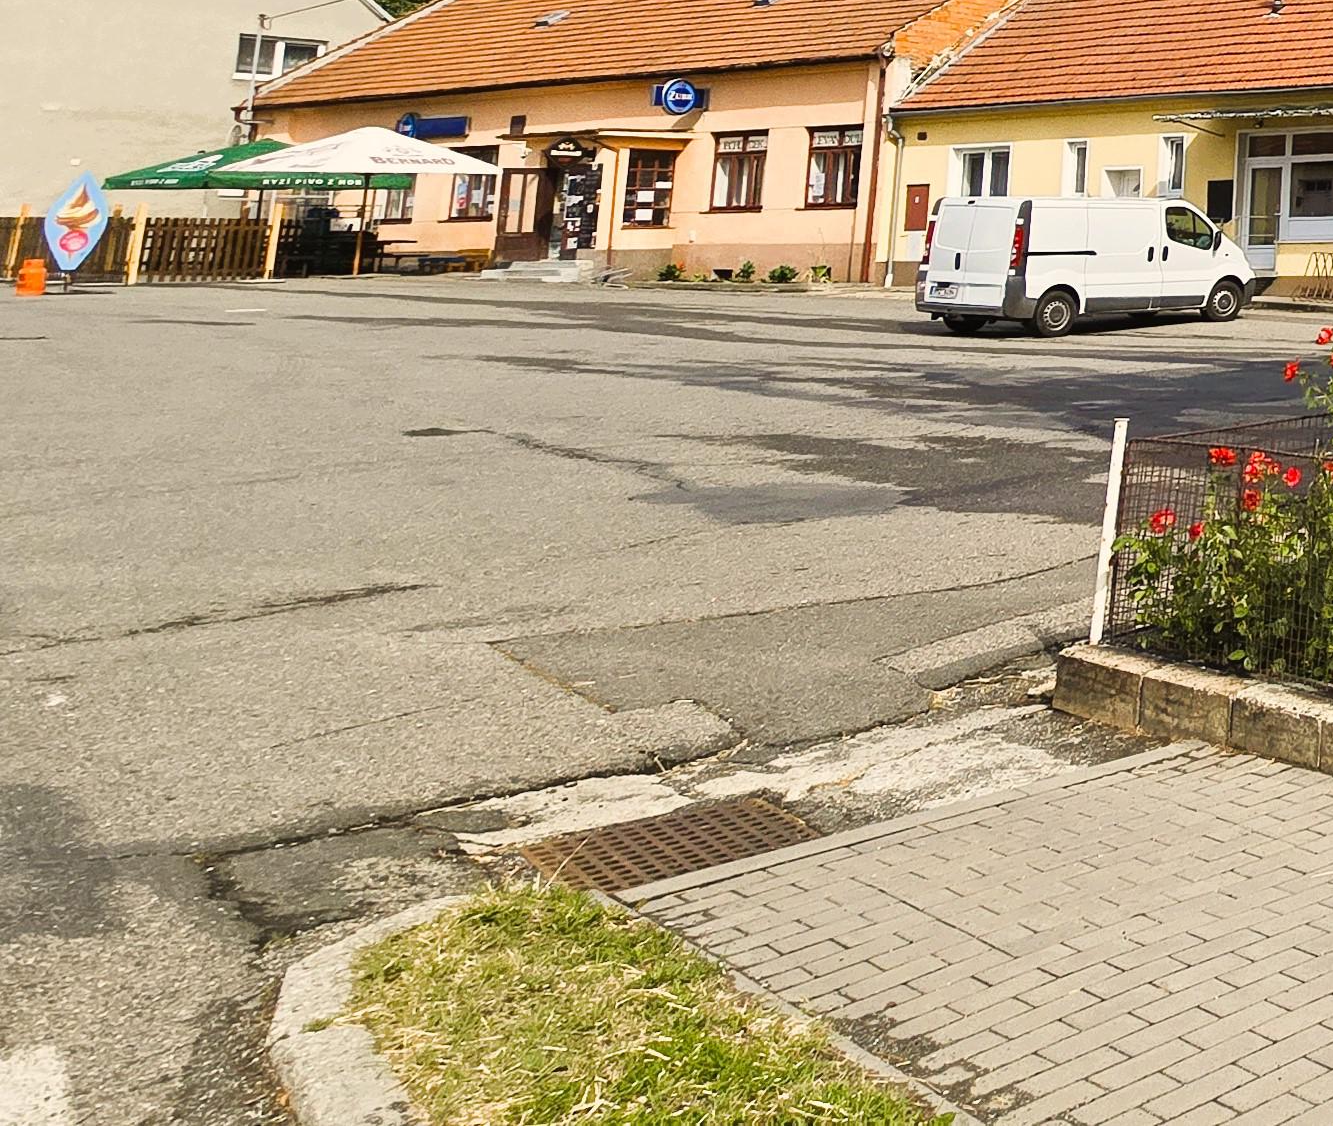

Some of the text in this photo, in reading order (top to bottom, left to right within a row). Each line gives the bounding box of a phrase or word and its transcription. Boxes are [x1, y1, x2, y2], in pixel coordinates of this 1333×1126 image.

[370, 156, 456, 166] BERNARD
[295, 178, 324, 186] PIVO
[327, 178, 335, 186] Z
